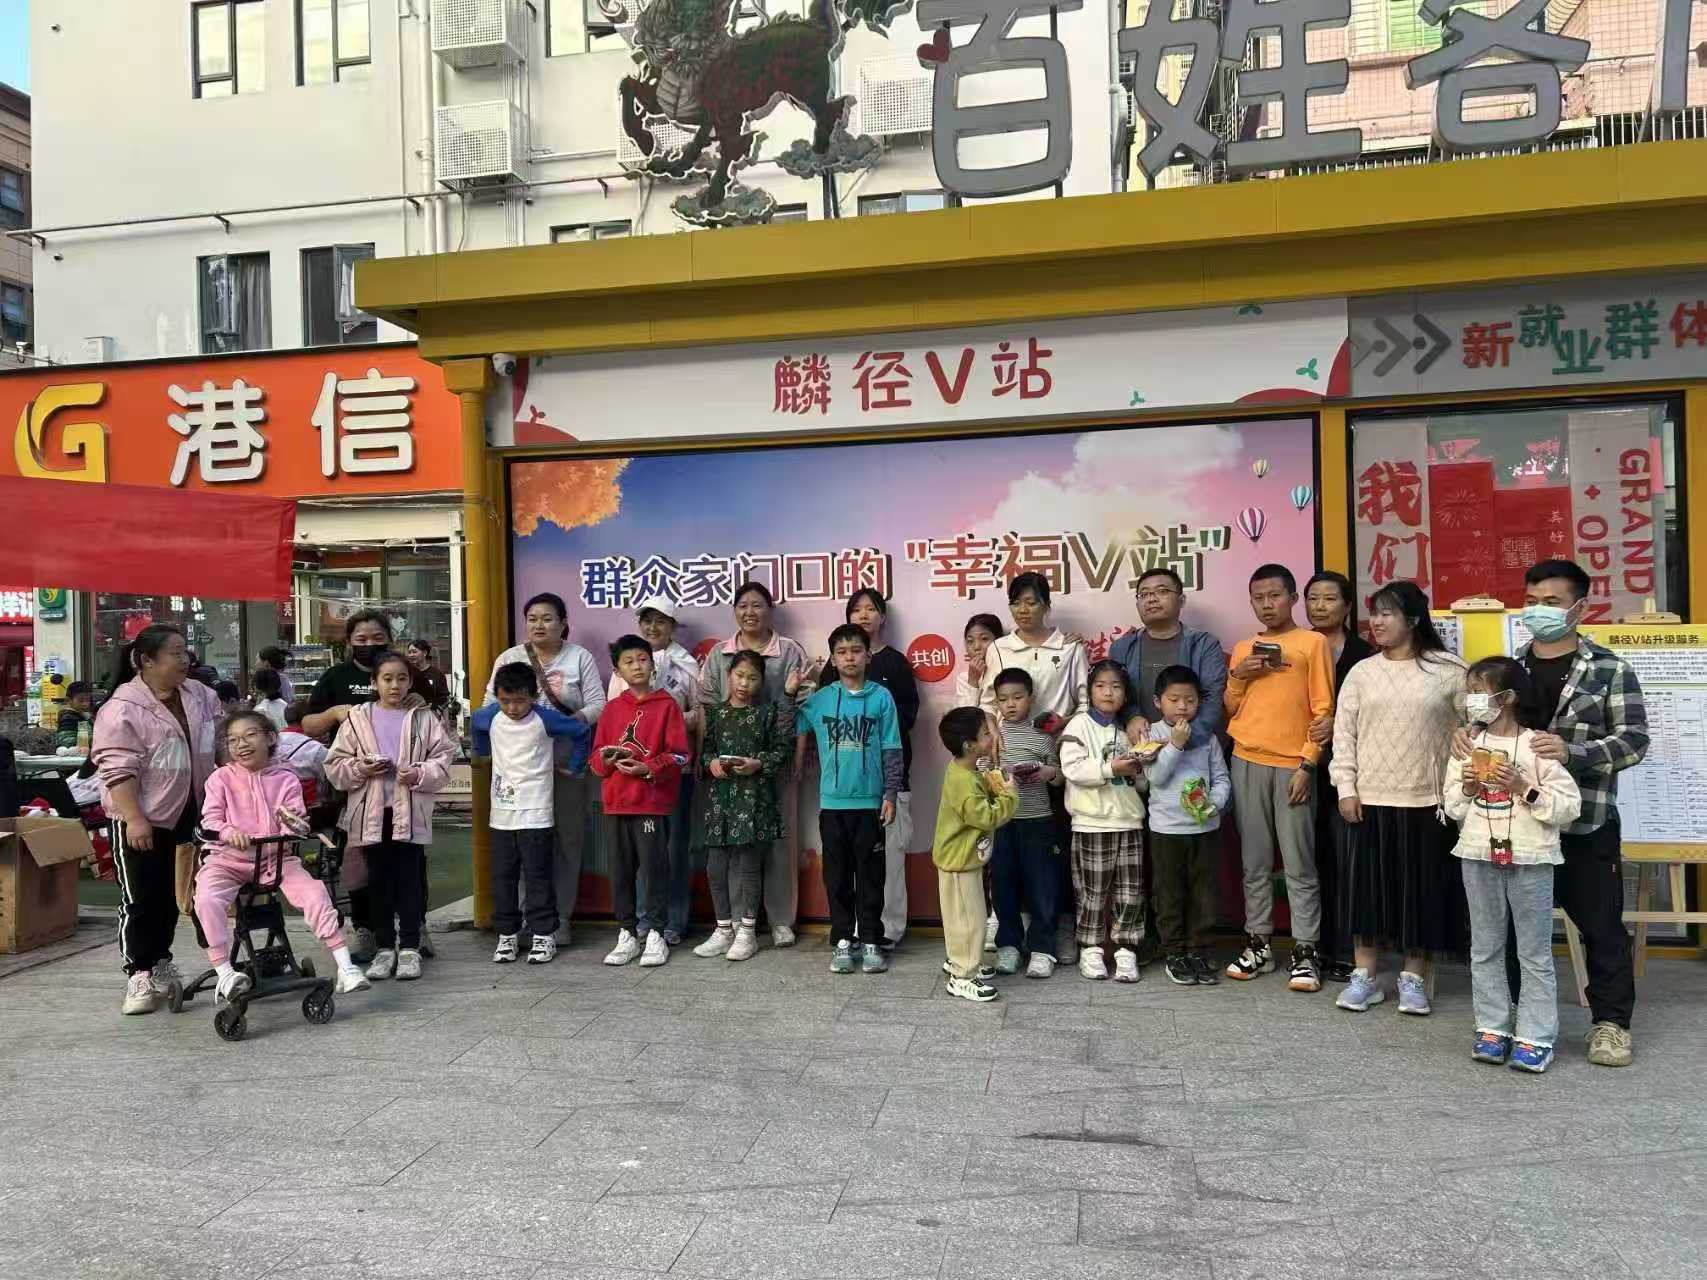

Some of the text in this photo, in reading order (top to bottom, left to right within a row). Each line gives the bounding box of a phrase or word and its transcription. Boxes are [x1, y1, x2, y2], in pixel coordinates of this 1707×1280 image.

[773, 336, 1053, 415] 麟径V站
[167, 367, 418, 488] 港信
[1619, 449, 1655, 595] GRAND
[911, 648, 950, 669] 共创
